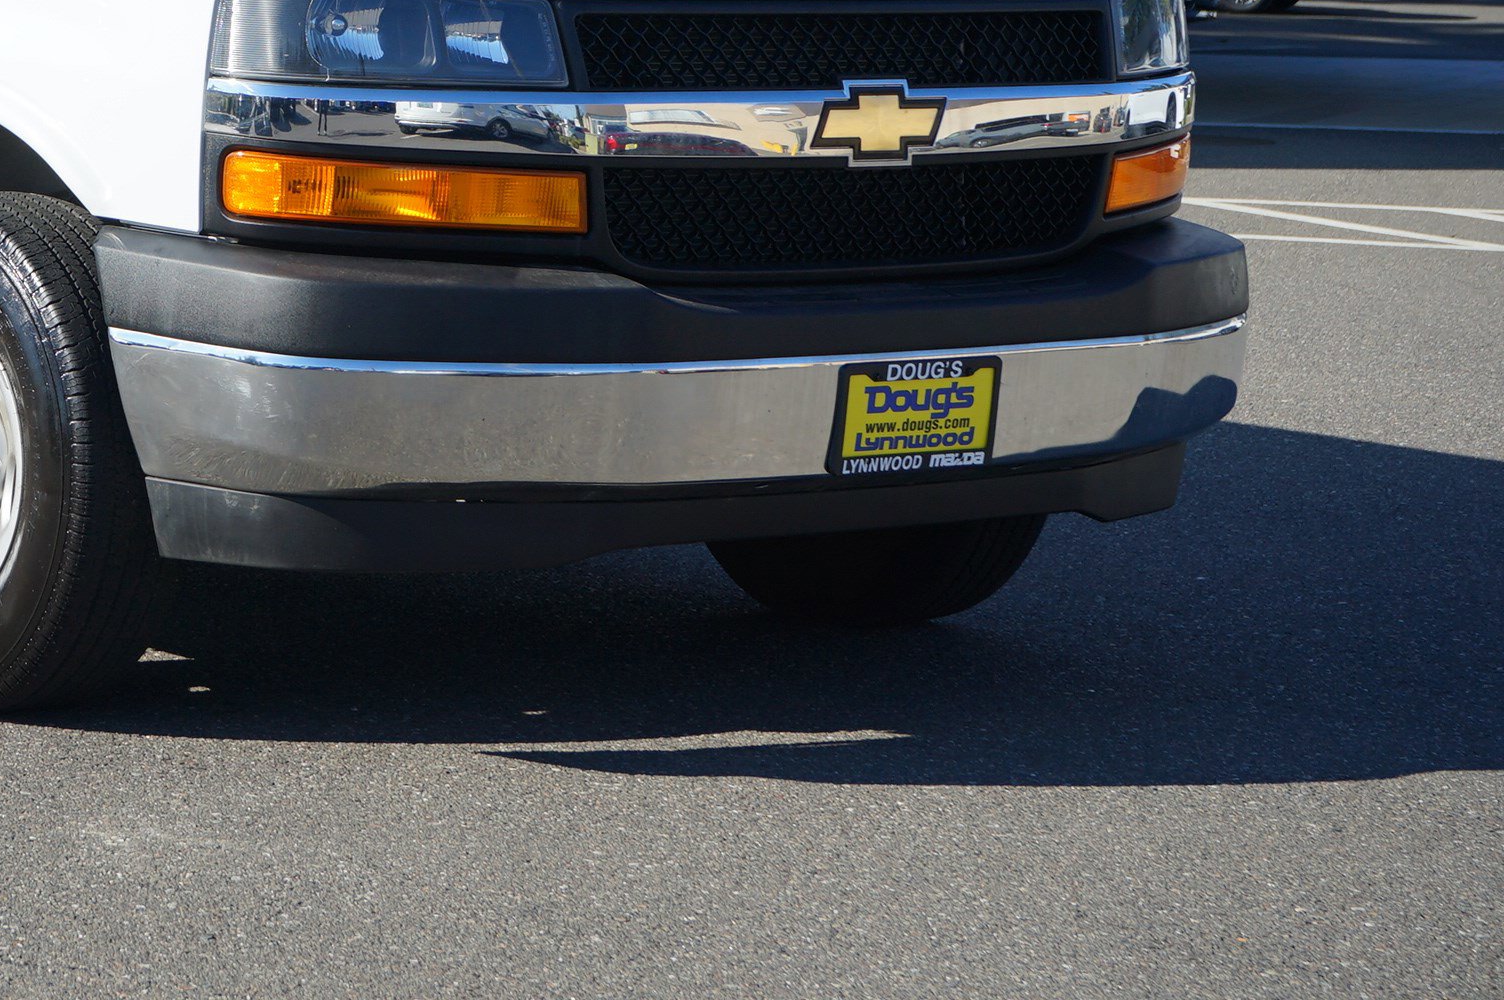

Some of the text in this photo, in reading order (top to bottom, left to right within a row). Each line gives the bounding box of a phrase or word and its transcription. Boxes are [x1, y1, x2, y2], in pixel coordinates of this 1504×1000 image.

[886, 360, 963, 381] DOUG'S
[865, 418, 970, 433] www.dougs.com
[854, 427, 975, 451] Lynnwood
[842, 455, 922, 475] LYNNWOOD
